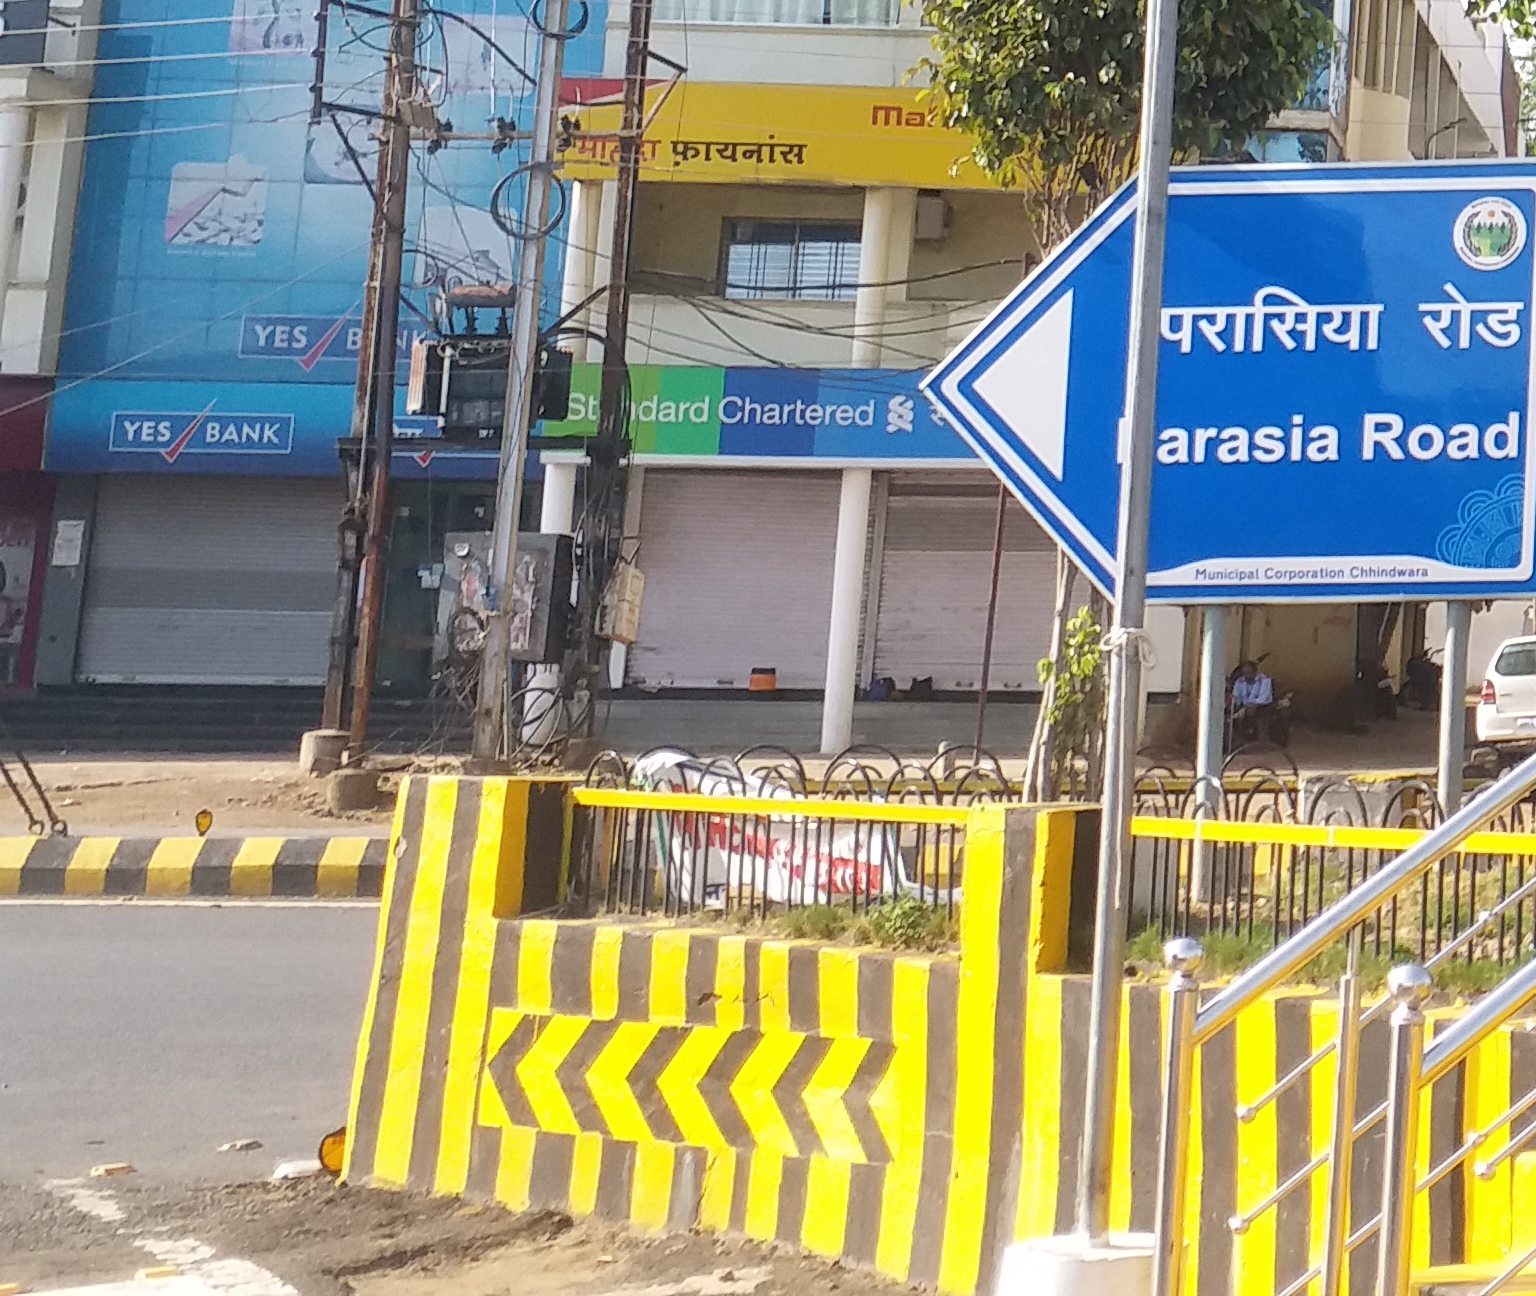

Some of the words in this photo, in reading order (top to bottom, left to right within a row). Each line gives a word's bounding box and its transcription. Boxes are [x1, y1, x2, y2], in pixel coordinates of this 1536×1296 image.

[1159, 285, 1386, 354] परासिया
[1418, 282, 1525, 350] रोड
[254, 325, 308, 348] YES
[567, 393, 710, 425] Stndard
[718, 394, 875, 427] Chartered
[123, 420, 172, 443] YES
[205, 421, 282, 445] BANK
[1361, 410, 1521, 462] Road
[1195, 568, 1260, 582] Municipal
[1264, 567, 1345, 582] Corporation
[1349, 566, 1429, 580] Chhindwara
